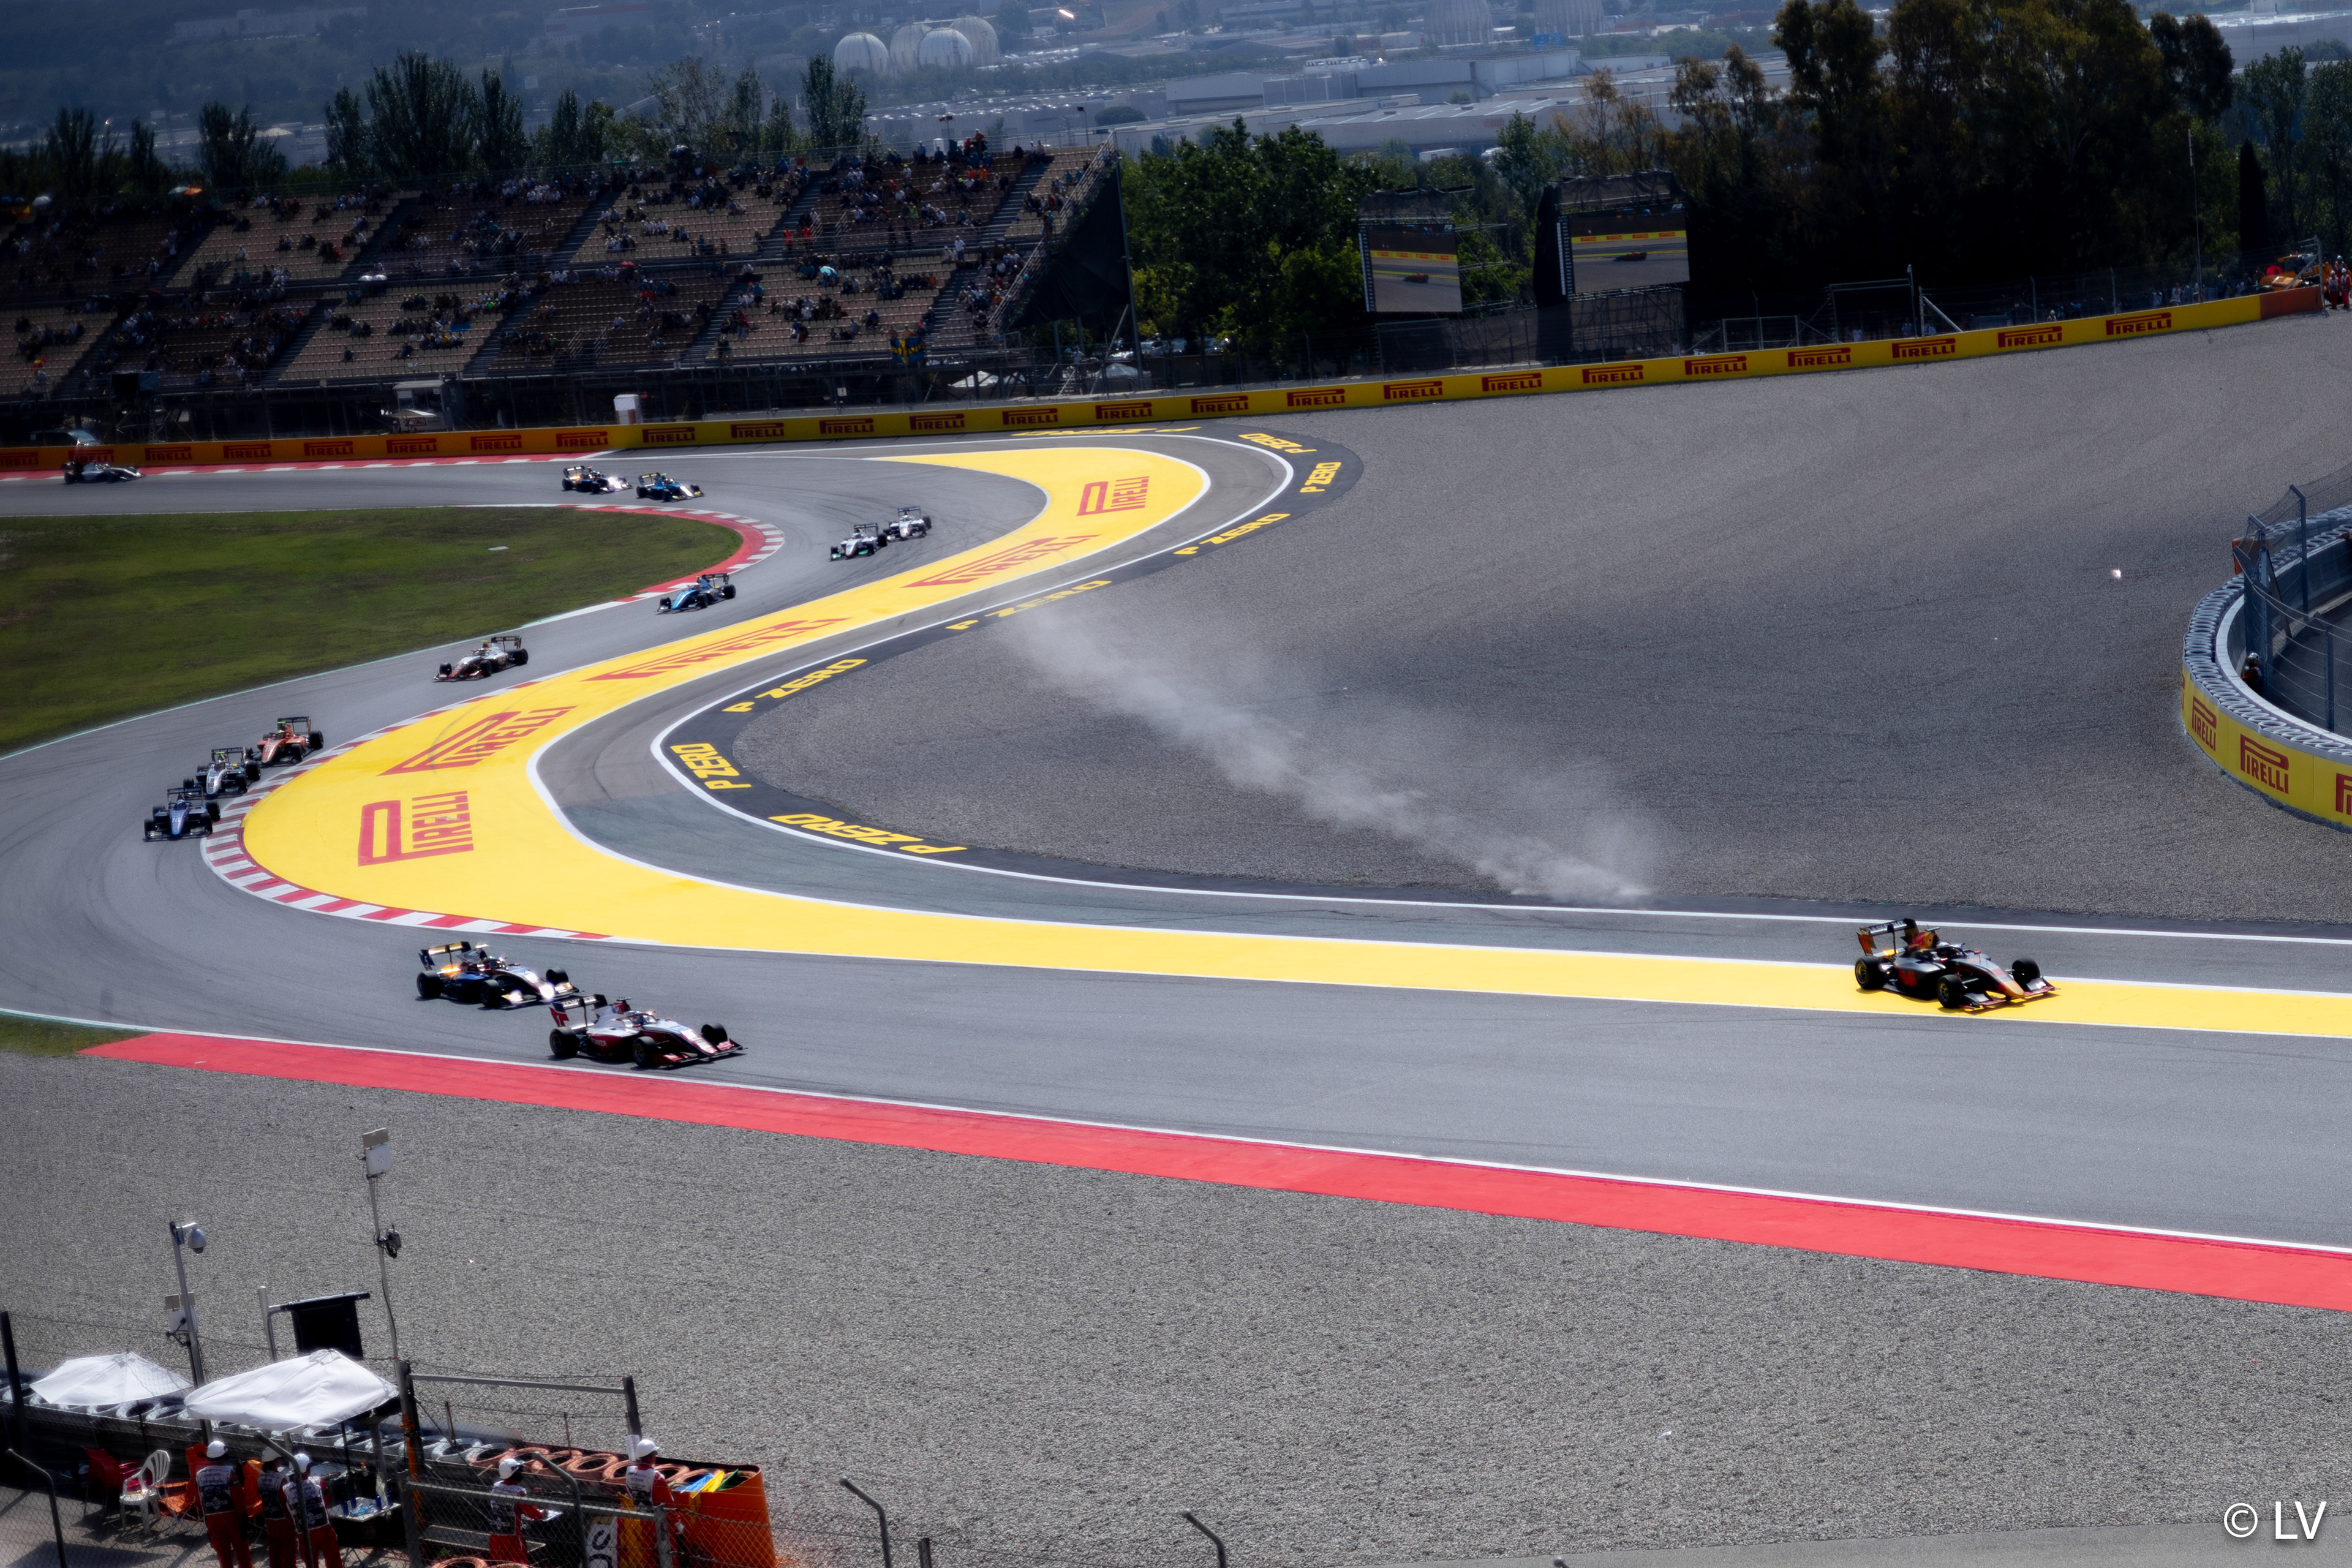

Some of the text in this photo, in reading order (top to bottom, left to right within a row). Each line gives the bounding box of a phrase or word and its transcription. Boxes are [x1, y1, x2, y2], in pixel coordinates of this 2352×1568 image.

[2106, 312, 2171, 336] PIRELLI
[1997, 326, 2062, 348] PIRELLI
[1788, 347, 1850, 367] PIRELLI
[1891, 338, 1955, 358] PIRELLI
[1583, 365, 1643, 384] PIRELLI
[1685, 356, 1746, 375] PIRELLI
[1384, 381, 1442, 399] PIRELLI
[1482, 373, 1542, 392] PIRELLI
[1191, 395, 1248, 413] PIRELLI
[1287, 389, 1345, 407] PIRELLI
[1002, 408, 1058, 425] PIRELLI
[1095, 402, 1152, 420] PIRELLI
[731, 422, 785, 439] PIRELLI
[820, 418, 874, 434] PIRELLI
[910, 413, 965, 430] PIRELLI
[470, 434, 522, 450] PIRELLI
[556, 431, 608, 447] PIRELLI
[642, 427, 695, 443] PIRELLI
[1238, 433, 1301, 448] ZERO
[145, 447, 192, 461] PIRELLI
[223, 443, 271, 459] PIRELLI
[304, 440, 353, 456] PIRELLI
[386, 438, 437, 453] PIRELLI
[68, 449, 115, 464] PIRELLI
[1305, 461, 1341, 486] ZERO
[1077, 476, 1150, 516] PIRELLI
[1173, 513, 1291, 556] P ZERO
[899, 535, 1102, 588] PIRELLI
[945, 580, 1112, 630] P ZERO
[578, 617, 853, 682] PIRELLI
[722, 658, 868, 712] P ZERO
[2192, 695, 2217, 752] PIRELLI
[376, 706, 578, 777] PIRELLI
[669, 742, 752, 790] P ZERO
[2241, 734, 2289, 794] PIRELLI
[358, 790, 474, 867] PIRELLI
[767, 813, 968, 854] P ZERO
